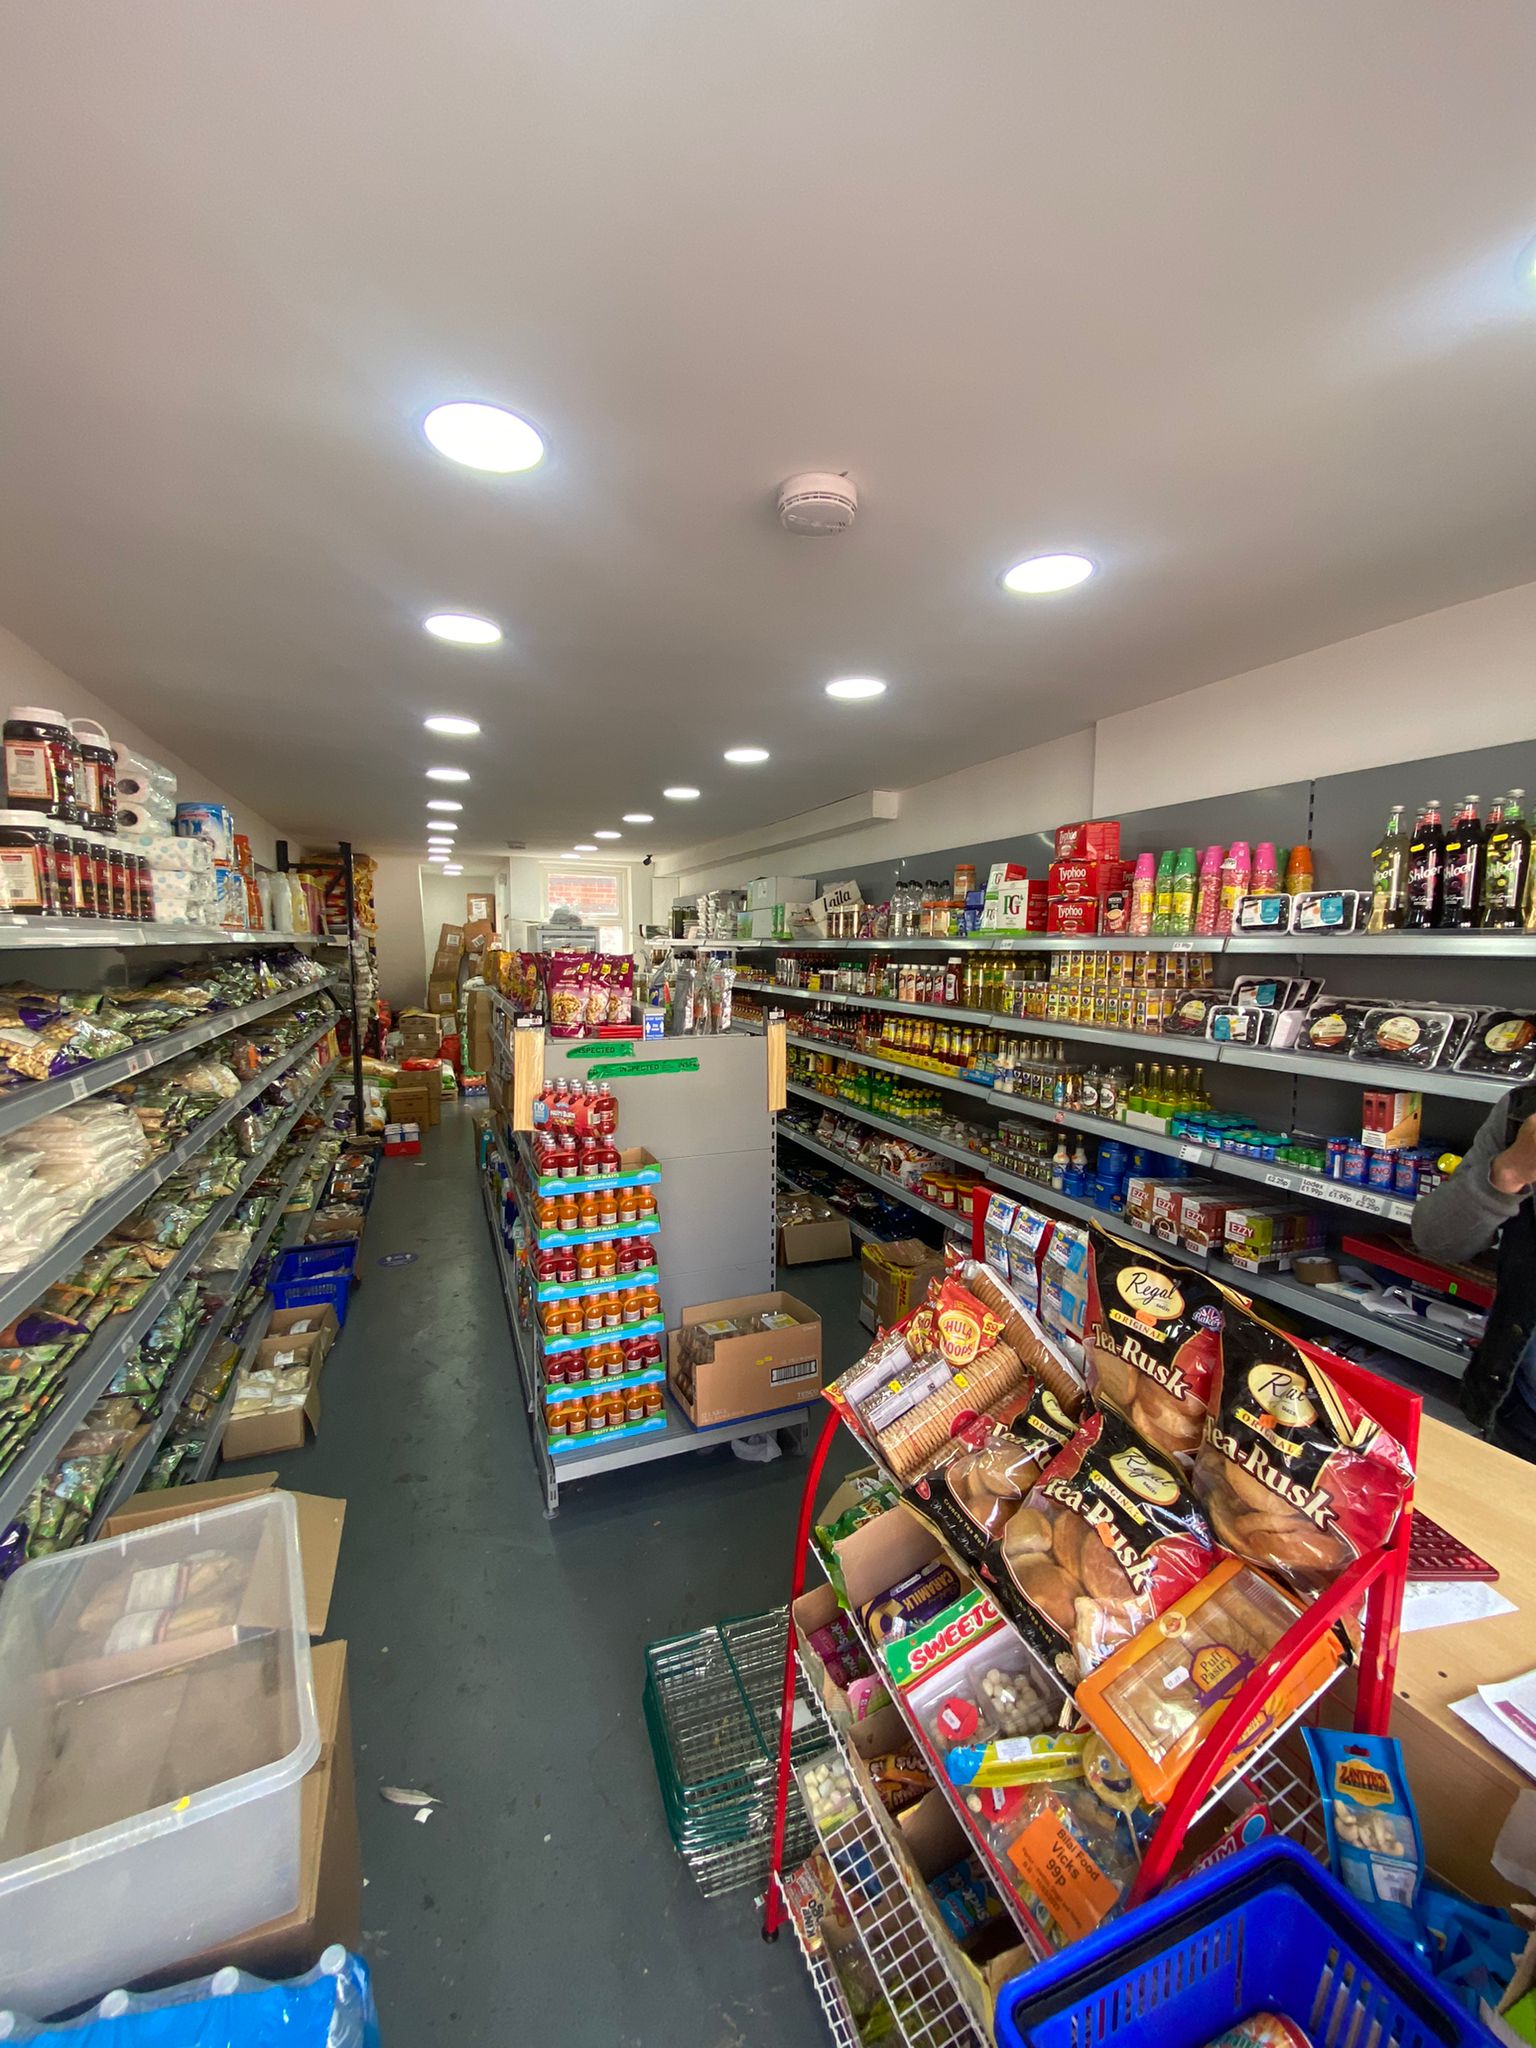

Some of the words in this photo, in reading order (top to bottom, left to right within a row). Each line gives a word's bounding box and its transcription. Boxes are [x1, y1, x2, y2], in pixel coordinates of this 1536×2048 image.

[1058, 866, 1087, 881] Typhoo
[1408, 864, 1443, 884] Shloer
[1003, 894, 1021, 915] PG
[1057, 904, 1084, 919] Typhoo
[619, 1063, 660, 1073] INSPECTED
[533, 1102, 545, 1111] no
[1345, 1161, 1363, 1169] ENO
[1371, 1166, 1390, 1175] ENO
[1132, 1188, 1149, 1201] EZZY
[1157, 1199, 1176, 1213] EZZY
[1186, 1210, 1207, 1225] EZZY
[1231, 1223, 1255, 1238] EZZY
[1125, 1271, 1182, 1306] Regal
[944, 1319, 973, 1338] HULA
[1113, 1312, 1163, 1341] ORIGINAL
[1091, 1323, 1193, 1400] Tea-Rusk
[1205, 1414, 1340, 1530] Tea-Rusk
[902, 1569, 953, 1612] CARAMILK
[1200, 1650, 1224, 1673] Puff
[1200, 1656, 1234, 1686] Pastry
[1051, 1841, 1080, 1879] Vicks
[1056, 1828, 1075, 1854] Bilal
[1075, 1851, 1100, 1882] Food
[1046, 1858, 1066, 1887] 99p
